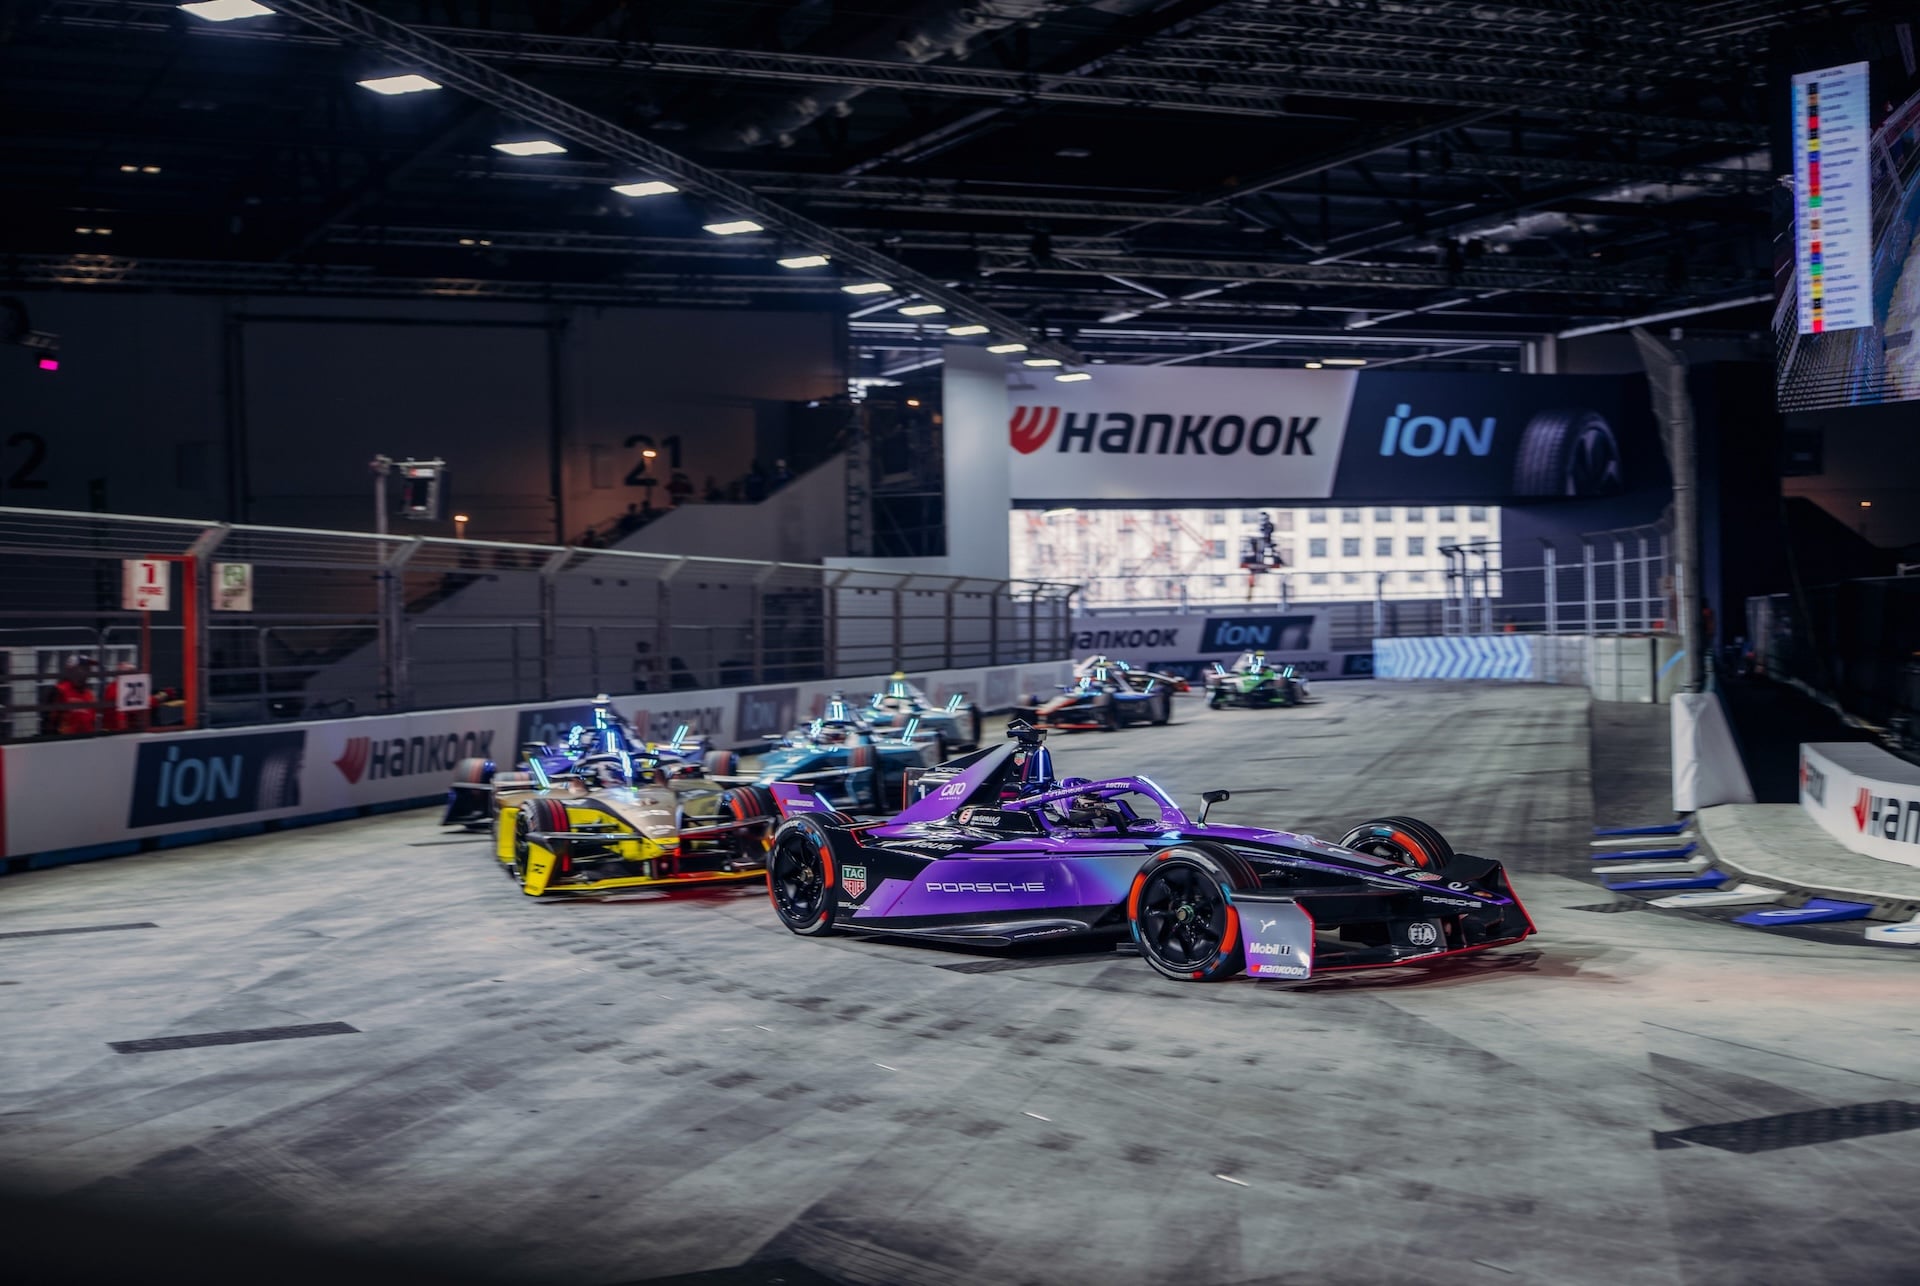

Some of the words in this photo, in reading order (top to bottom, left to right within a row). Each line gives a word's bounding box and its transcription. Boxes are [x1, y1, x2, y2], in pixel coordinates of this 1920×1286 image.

[1380, 403, 1496, 457] iON
[0, 432, 48, 489] 2
[624, 434, 681, 486] 21
[1215, 620, 1272, 645] iON
[157, 745, 243, 808] iON
[940, 782, 967, 796] CATO
[844, 867, 864, 879] TAG
[844, 880, 865, 896] HEUER
[926, 882, 1045, 892] PORSCHE
[1423, 895, 1482, 908] PORSCHE
[1410, 927, 1434, 941] FIA
[1249, 943, 1280, 955] Mobil
[1282, 944, 1291, 955] 1
